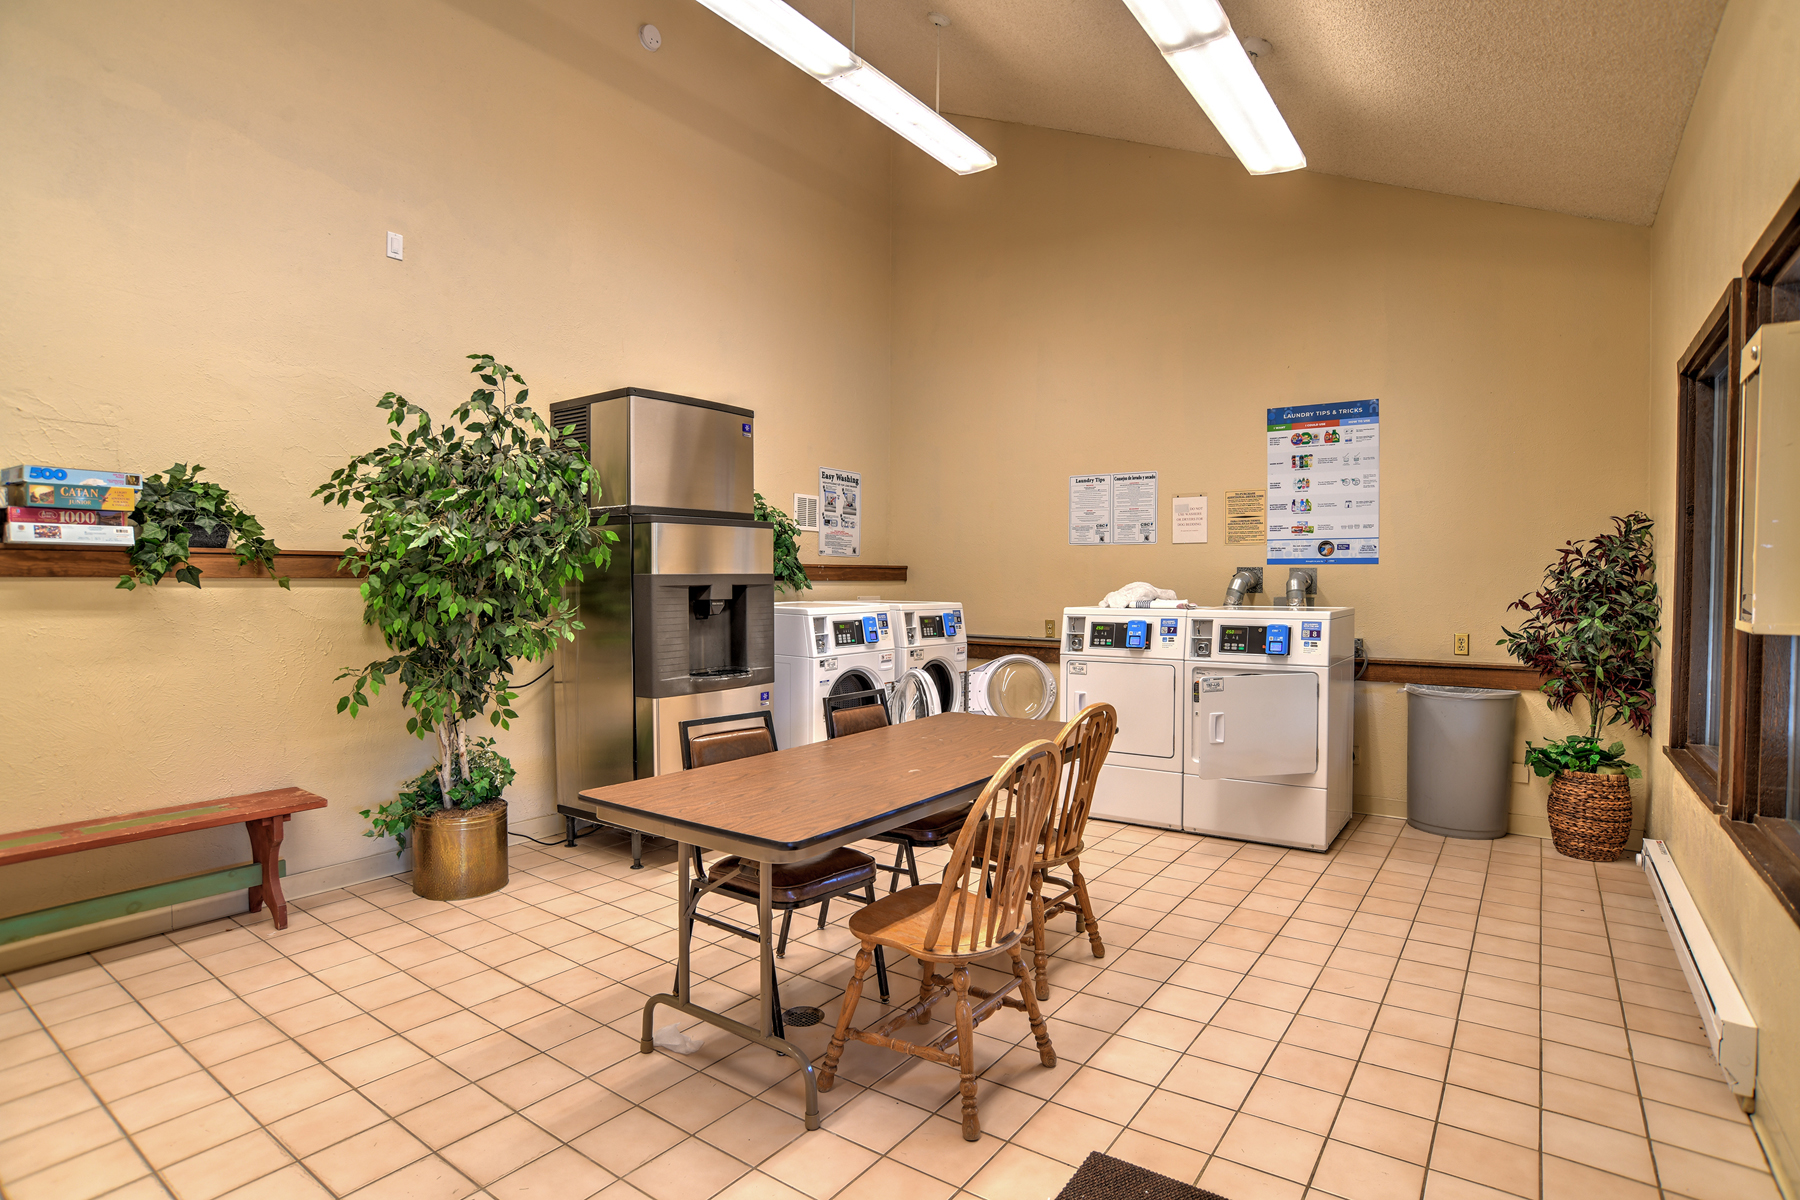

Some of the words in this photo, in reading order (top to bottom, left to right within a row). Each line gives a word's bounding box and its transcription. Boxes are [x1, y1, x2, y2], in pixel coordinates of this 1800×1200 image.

[1283, 411, 1314, 420] LAUNDRY
[30, 467, 68, 481] 500
[822, 471, 835, 482] Easy
[836, 473, 859, 486] Washing
[60, 486, 99, 498] CATAN
[59, 511, 96, 524] 1000
